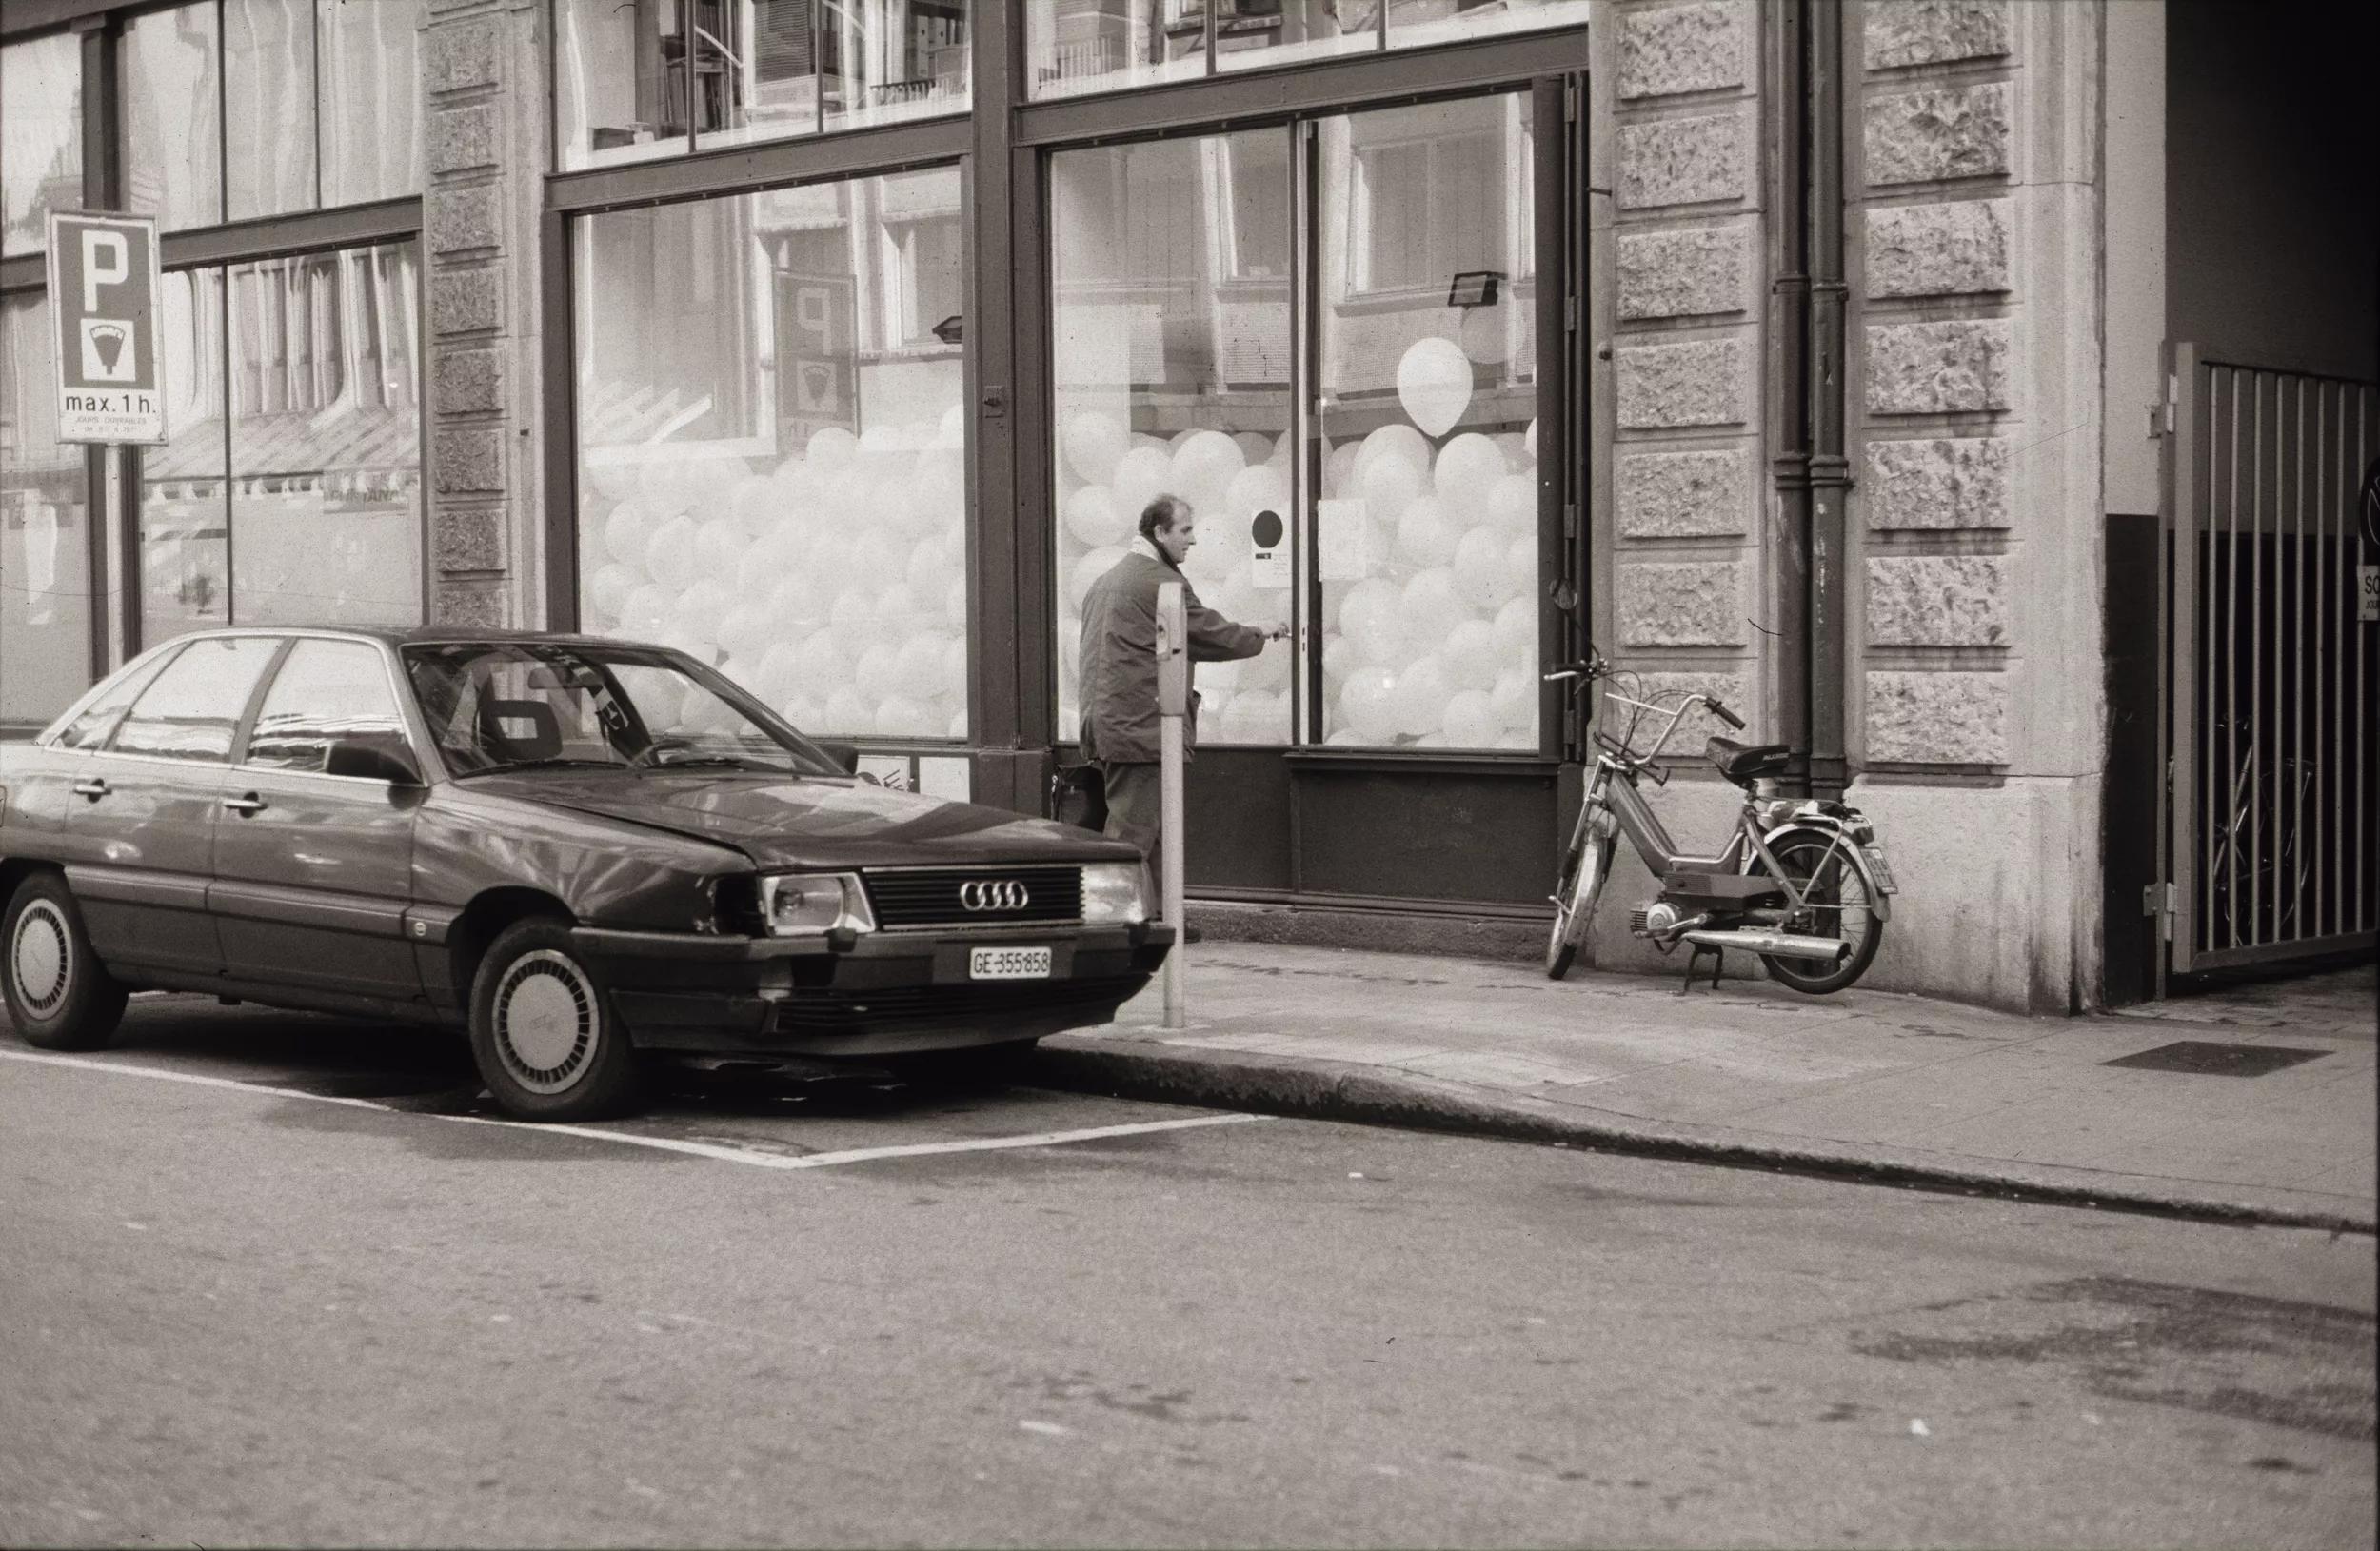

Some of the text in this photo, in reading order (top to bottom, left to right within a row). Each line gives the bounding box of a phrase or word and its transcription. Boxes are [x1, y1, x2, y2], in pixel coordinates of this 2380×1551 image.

[82, 229, 128, 311] P
[66, 394, 156, 413] max. 1 h.
